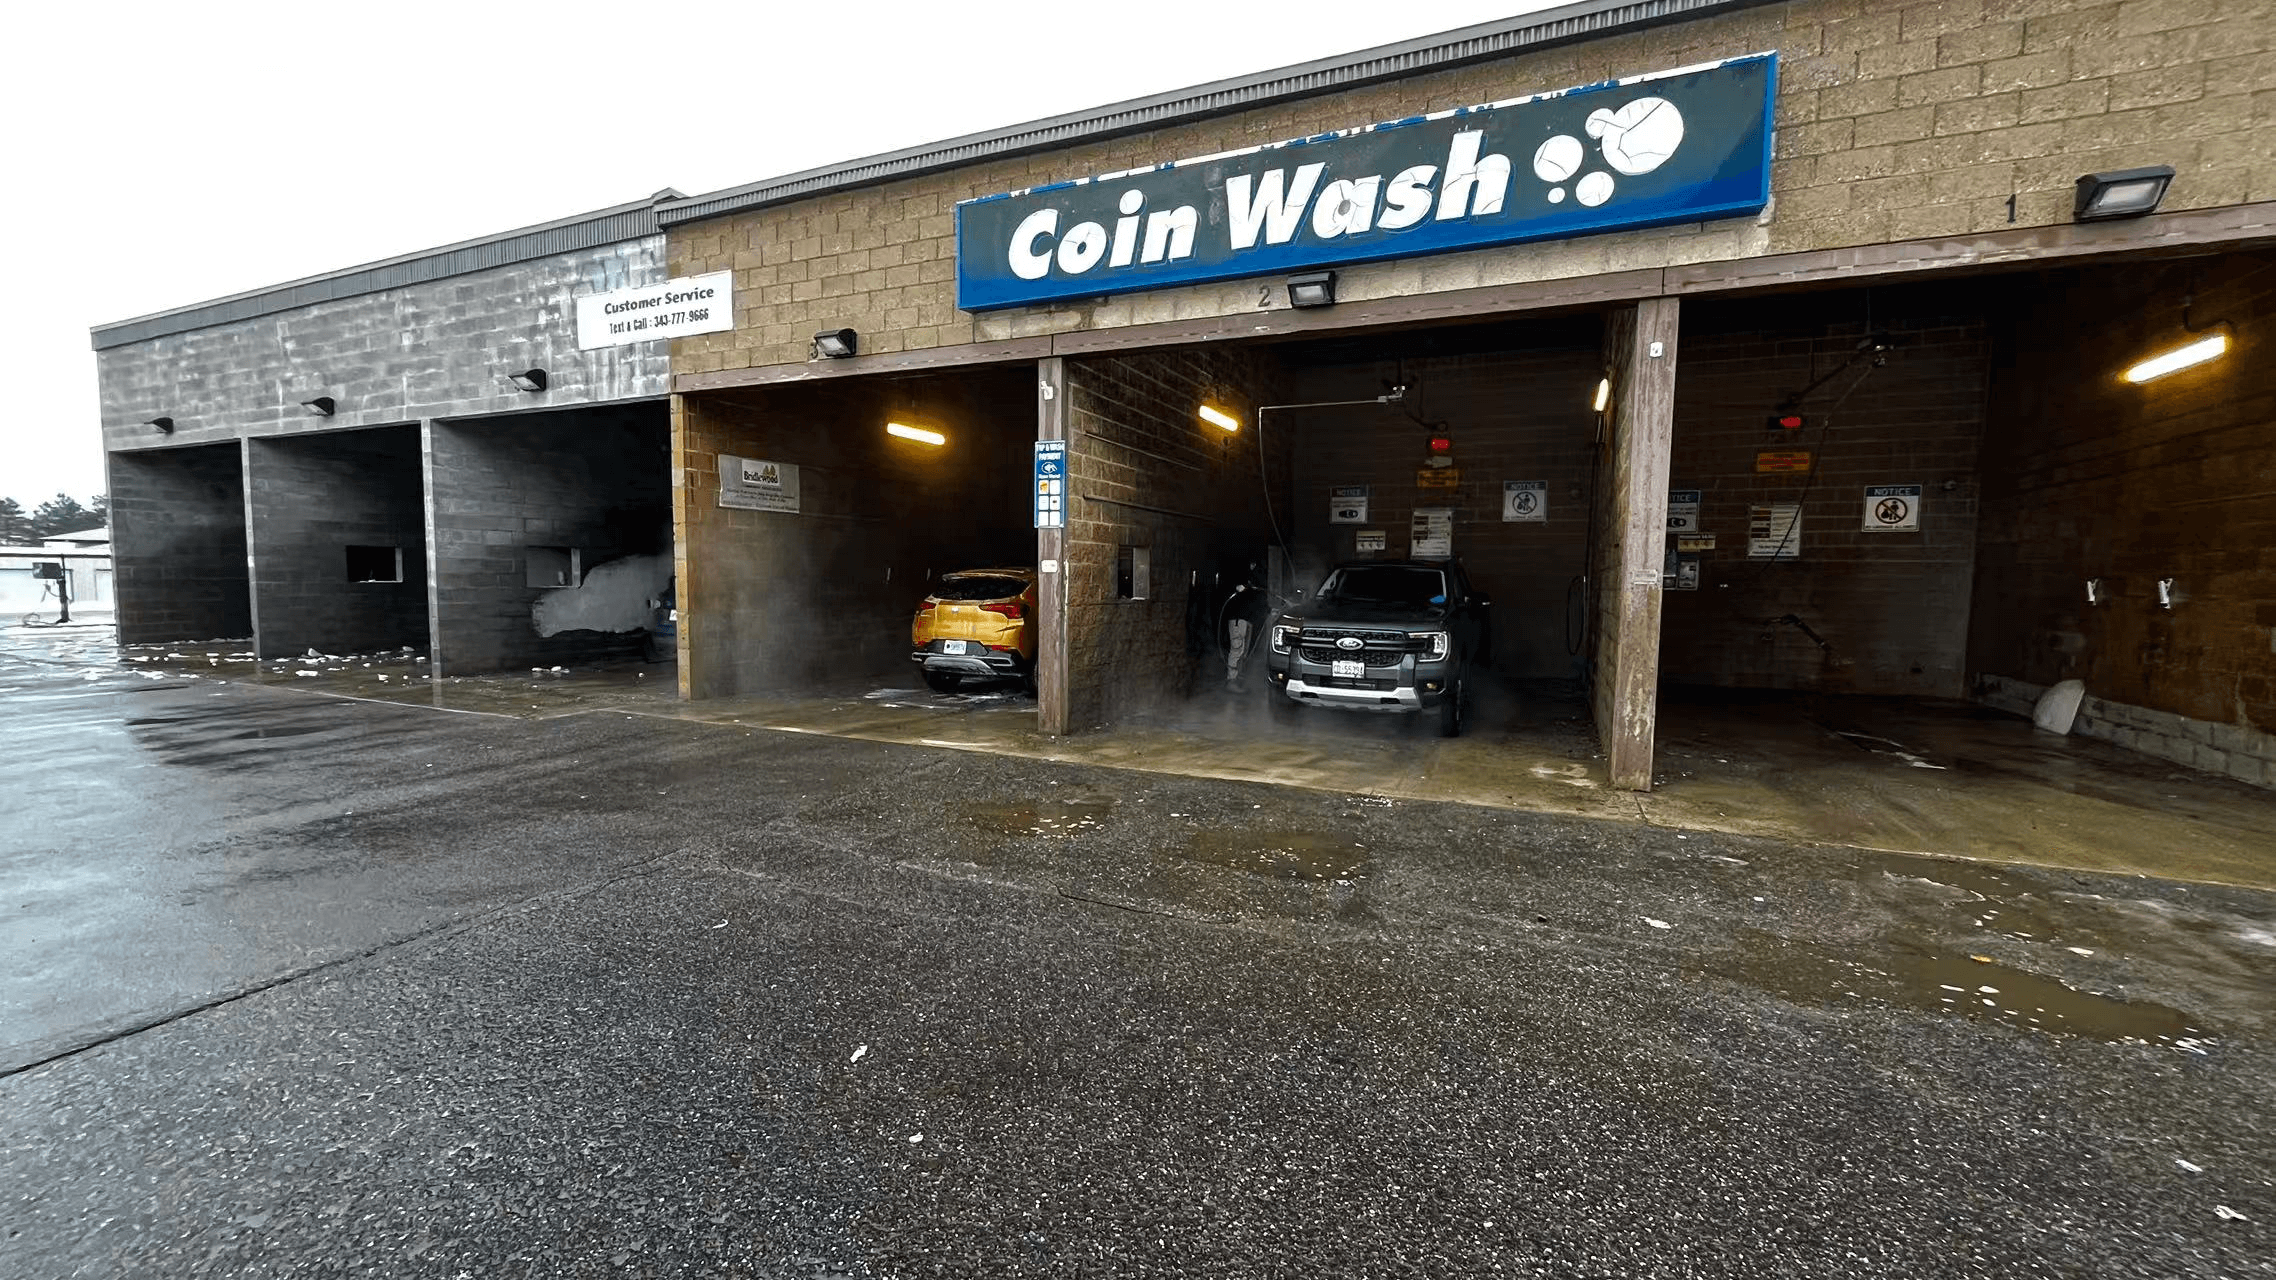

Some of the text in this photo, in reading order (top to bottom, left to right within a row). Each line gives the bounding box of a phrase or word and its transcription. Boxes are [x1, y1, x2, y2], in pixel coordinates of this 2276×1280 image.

[1008, 129, 1512, 280] Coin Wash
[2005, 194, 2017, 224] 1
[604, 287, 715, 315] Customer Service
[1257, 285, 1272, 308] 2
[609, 320, 625, 335] Text
[633, 317, 648, 331] Call
[654, 308, 709, 328] 343-777-9666
[1511, 482, 1540, 490] NOTICE
[1670, 494, 1692, 502] TICE
[1874, 487, 1912, 496] NOTICE
